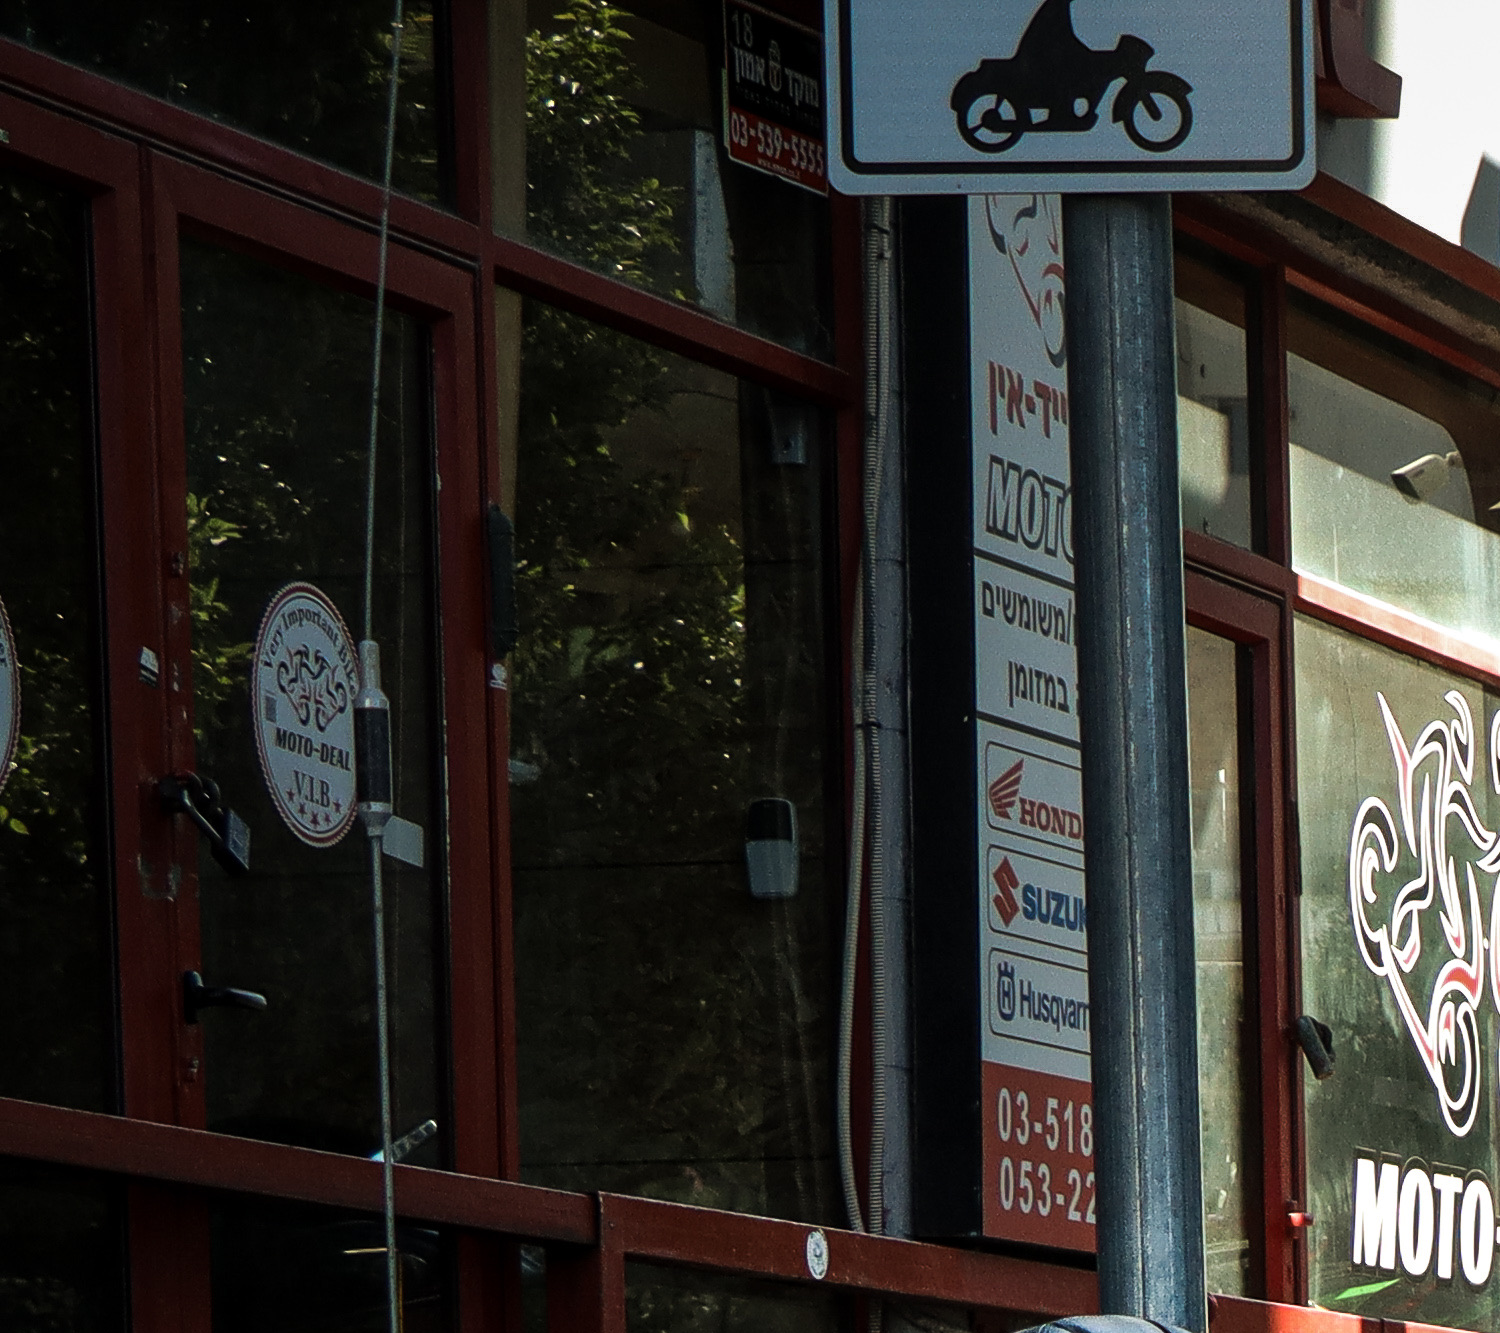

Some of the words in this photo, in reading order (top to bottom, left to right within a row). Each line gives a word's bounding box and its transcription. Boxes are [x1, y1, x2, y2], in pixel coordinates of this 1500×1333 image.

[731, 9, 753, 48] 18
[988, 360, 1068, 438] ייד-אין
[281, 608, 340, 649] Important
[275, 727, 352, 772] MOTO-DEAL
[1019, 797, 1083, 840] HOND
[1022, 884, 1087, 933] SUZUK
[997, 1087, 1094, 1157] 03-518
[999, 1156, 1097, 1225] 053-22
